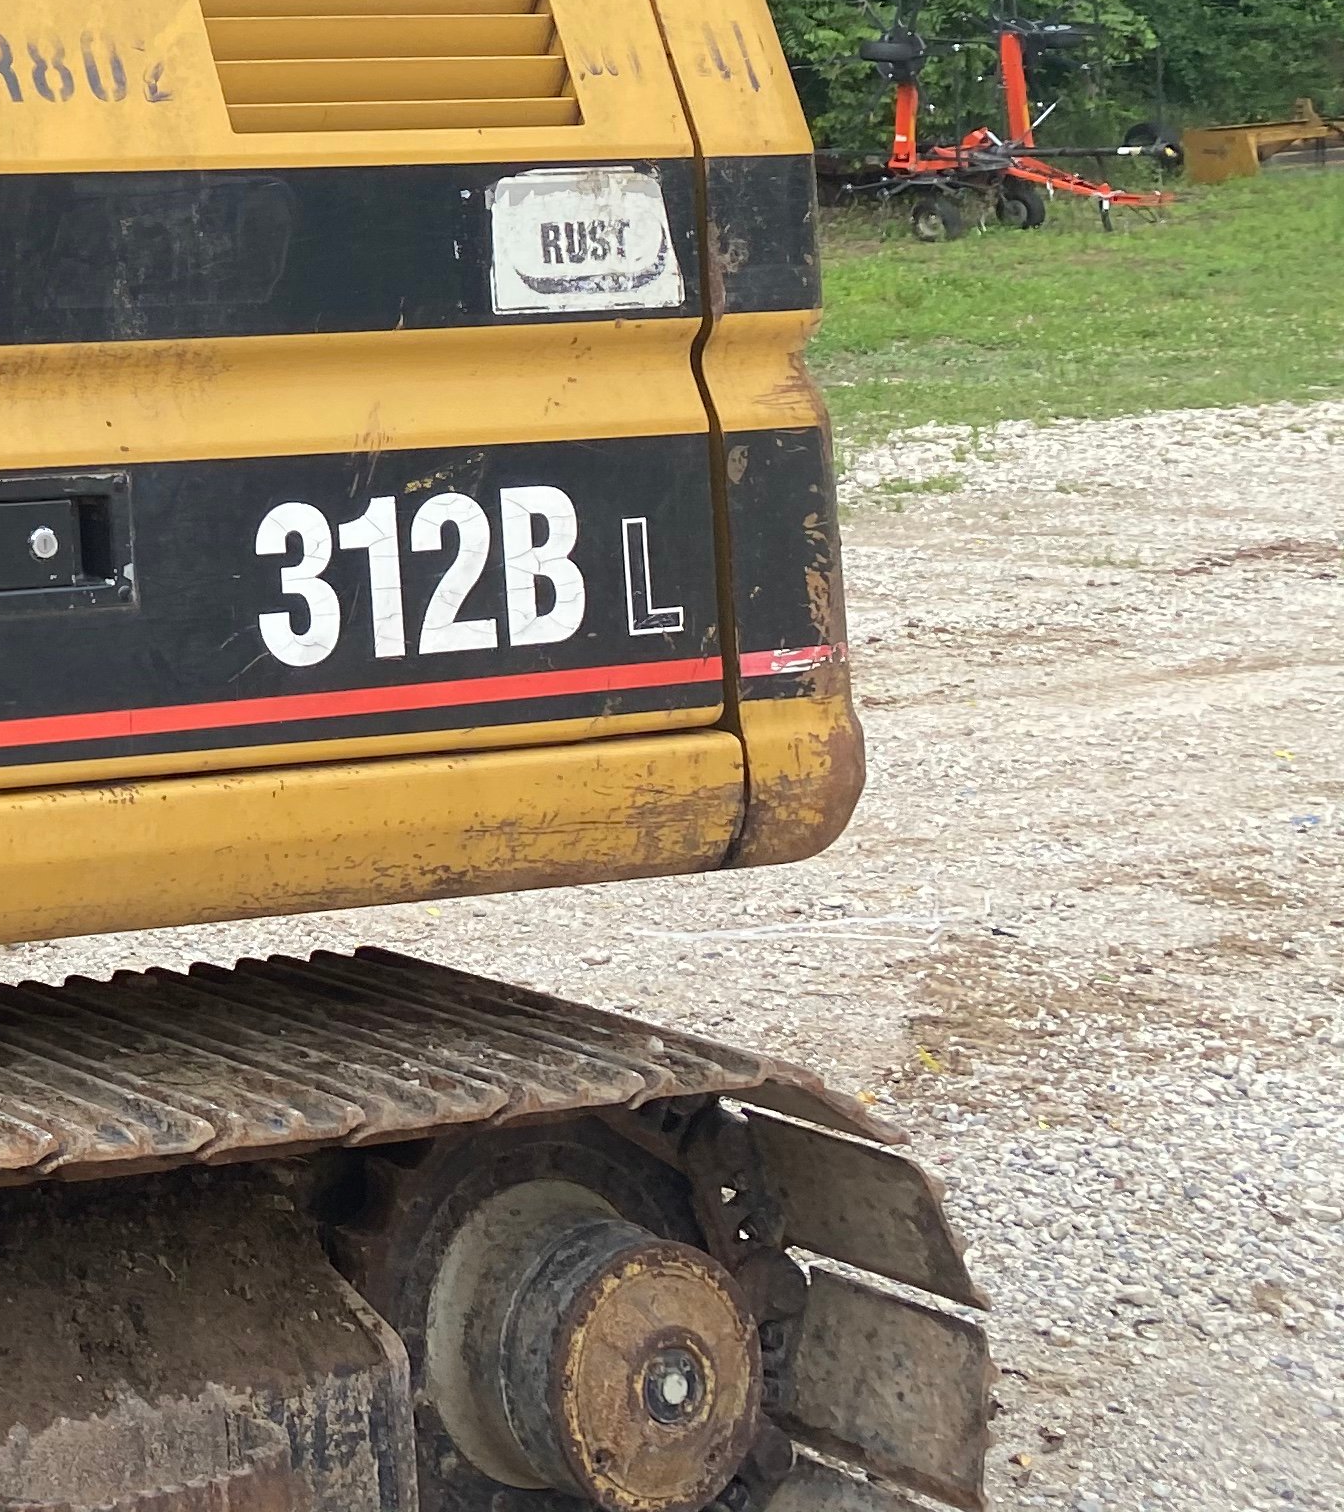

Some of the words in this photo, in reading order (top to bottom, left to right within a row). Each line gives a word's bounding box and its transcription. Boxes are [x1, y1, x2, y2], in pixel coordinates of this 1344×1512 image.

[540, 219, 630, 264] RUST
[255, 484, 585, 667] 312B
[620, 516, 684, 635] L
